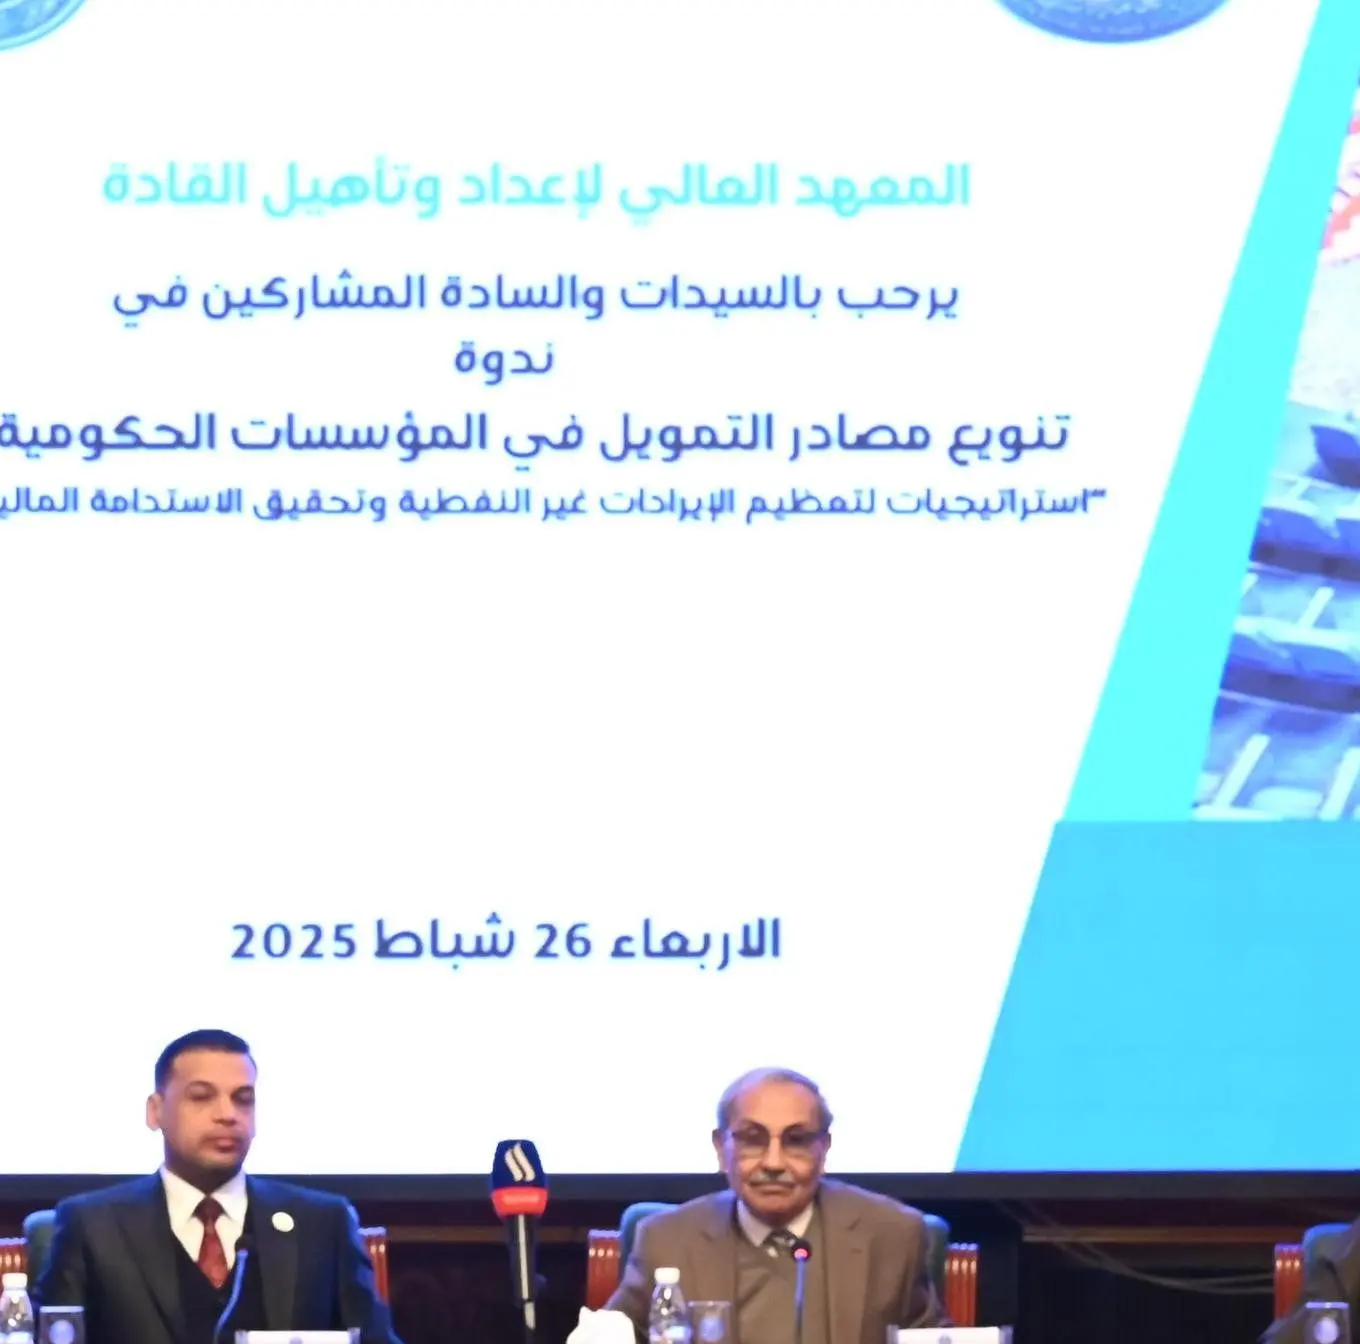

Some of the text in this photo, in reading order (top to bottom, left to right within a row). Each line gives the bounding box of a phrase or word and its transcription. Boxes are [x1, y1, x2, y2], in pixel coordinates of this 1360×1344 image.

[101, 154, 971, 228] المعهد العالي لإعداد وتأهيل القادة
[112, 268, 959, 329] يرحب بالسيدات والسادة المشاركين في
[454, 340, 554, 387] ندوة
[230, 410, 488, 464] المؤسسات
[503, 414, 585, 474] في
[599, 412, 774, 464] التمويل
[788, 412, 932, 462] مصادر
[947, 414, 1072, 468] تنويع
[89, 487, 243, 515] الاستدامة
[252, 488, 387, 523] وتحقيق
[398, 487, 532, 522] النفطية
[541, 488, 588, 523] غير
[599, 487, 736, 523] الإيرادات
[745, 486, 876, 526] لتعظيم
[230, 911, 781, 972] الاربعاء 26 شباط 2025
